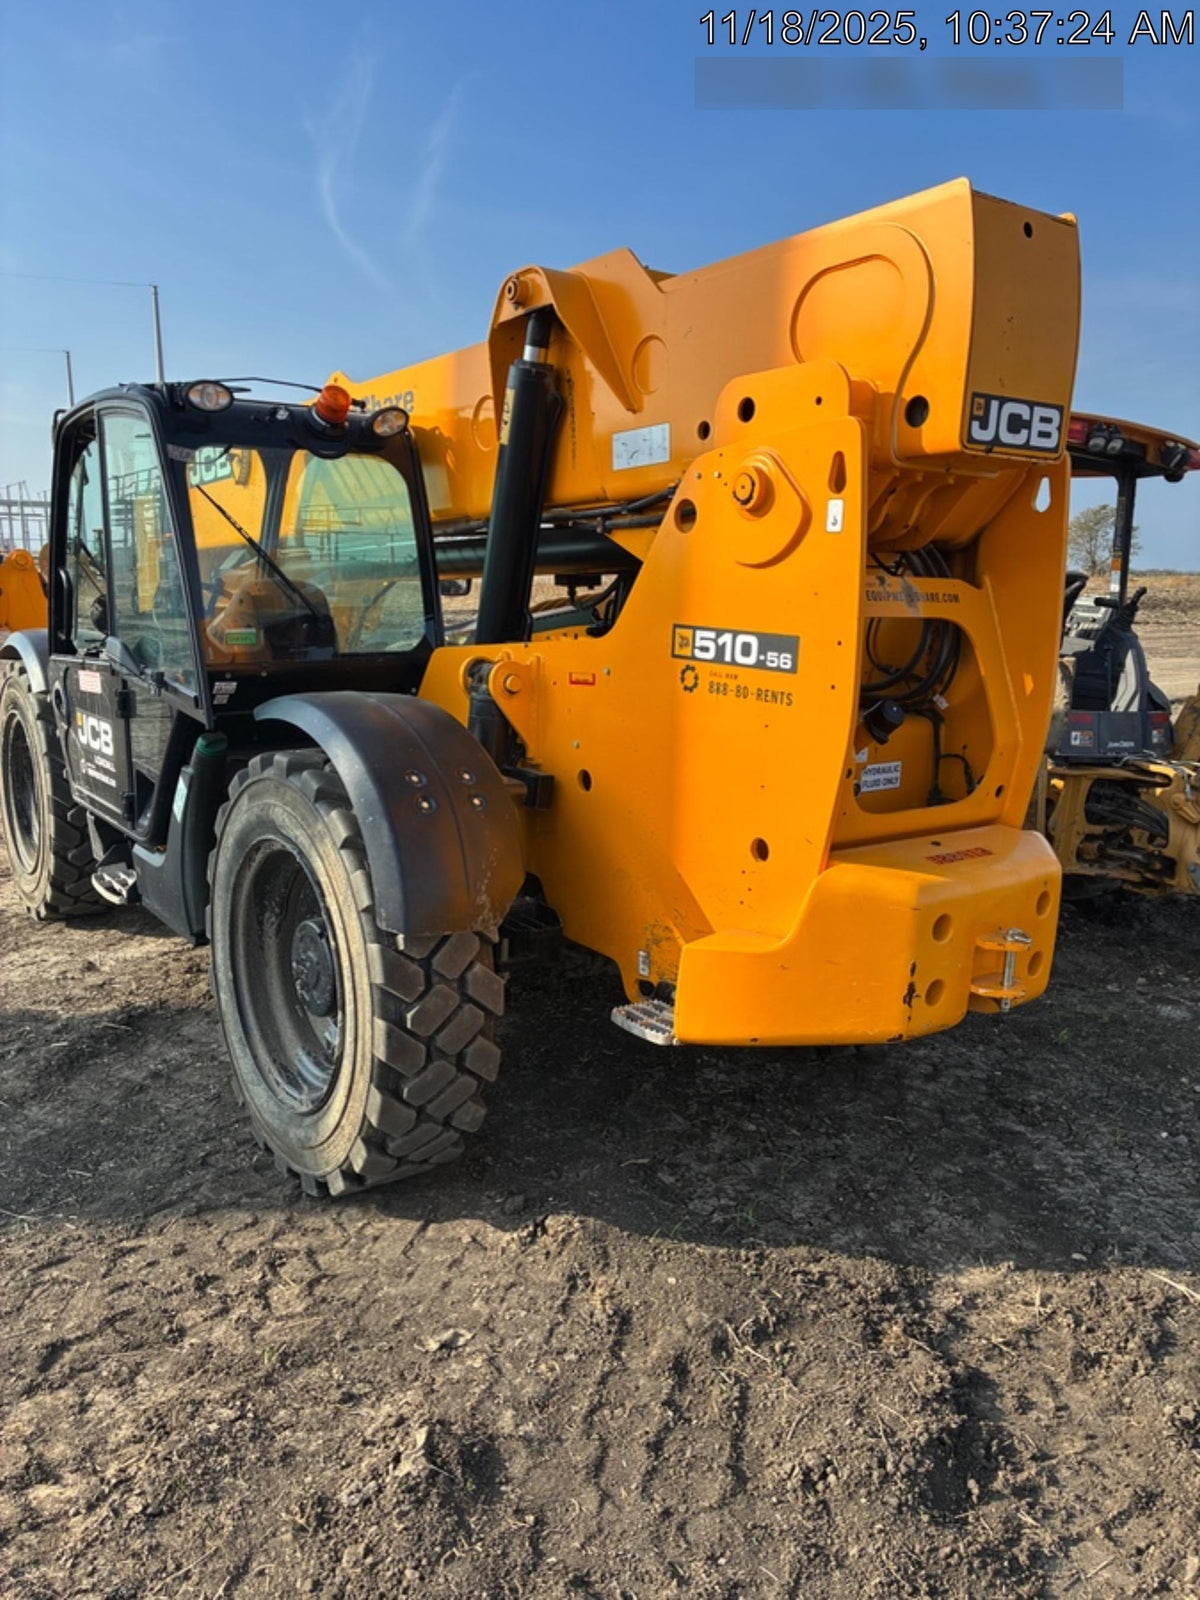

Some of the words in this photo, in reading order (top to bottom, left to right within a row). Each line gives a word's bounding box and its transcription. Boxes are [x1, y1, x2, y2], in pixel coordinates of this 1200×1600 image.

[971, 399, 1060, 449] JCB
[189, 446, 232, 487] JCB
[708, 681, 793, 706] 888-80-RENTS
[78, 713, 114, 756] JCB
